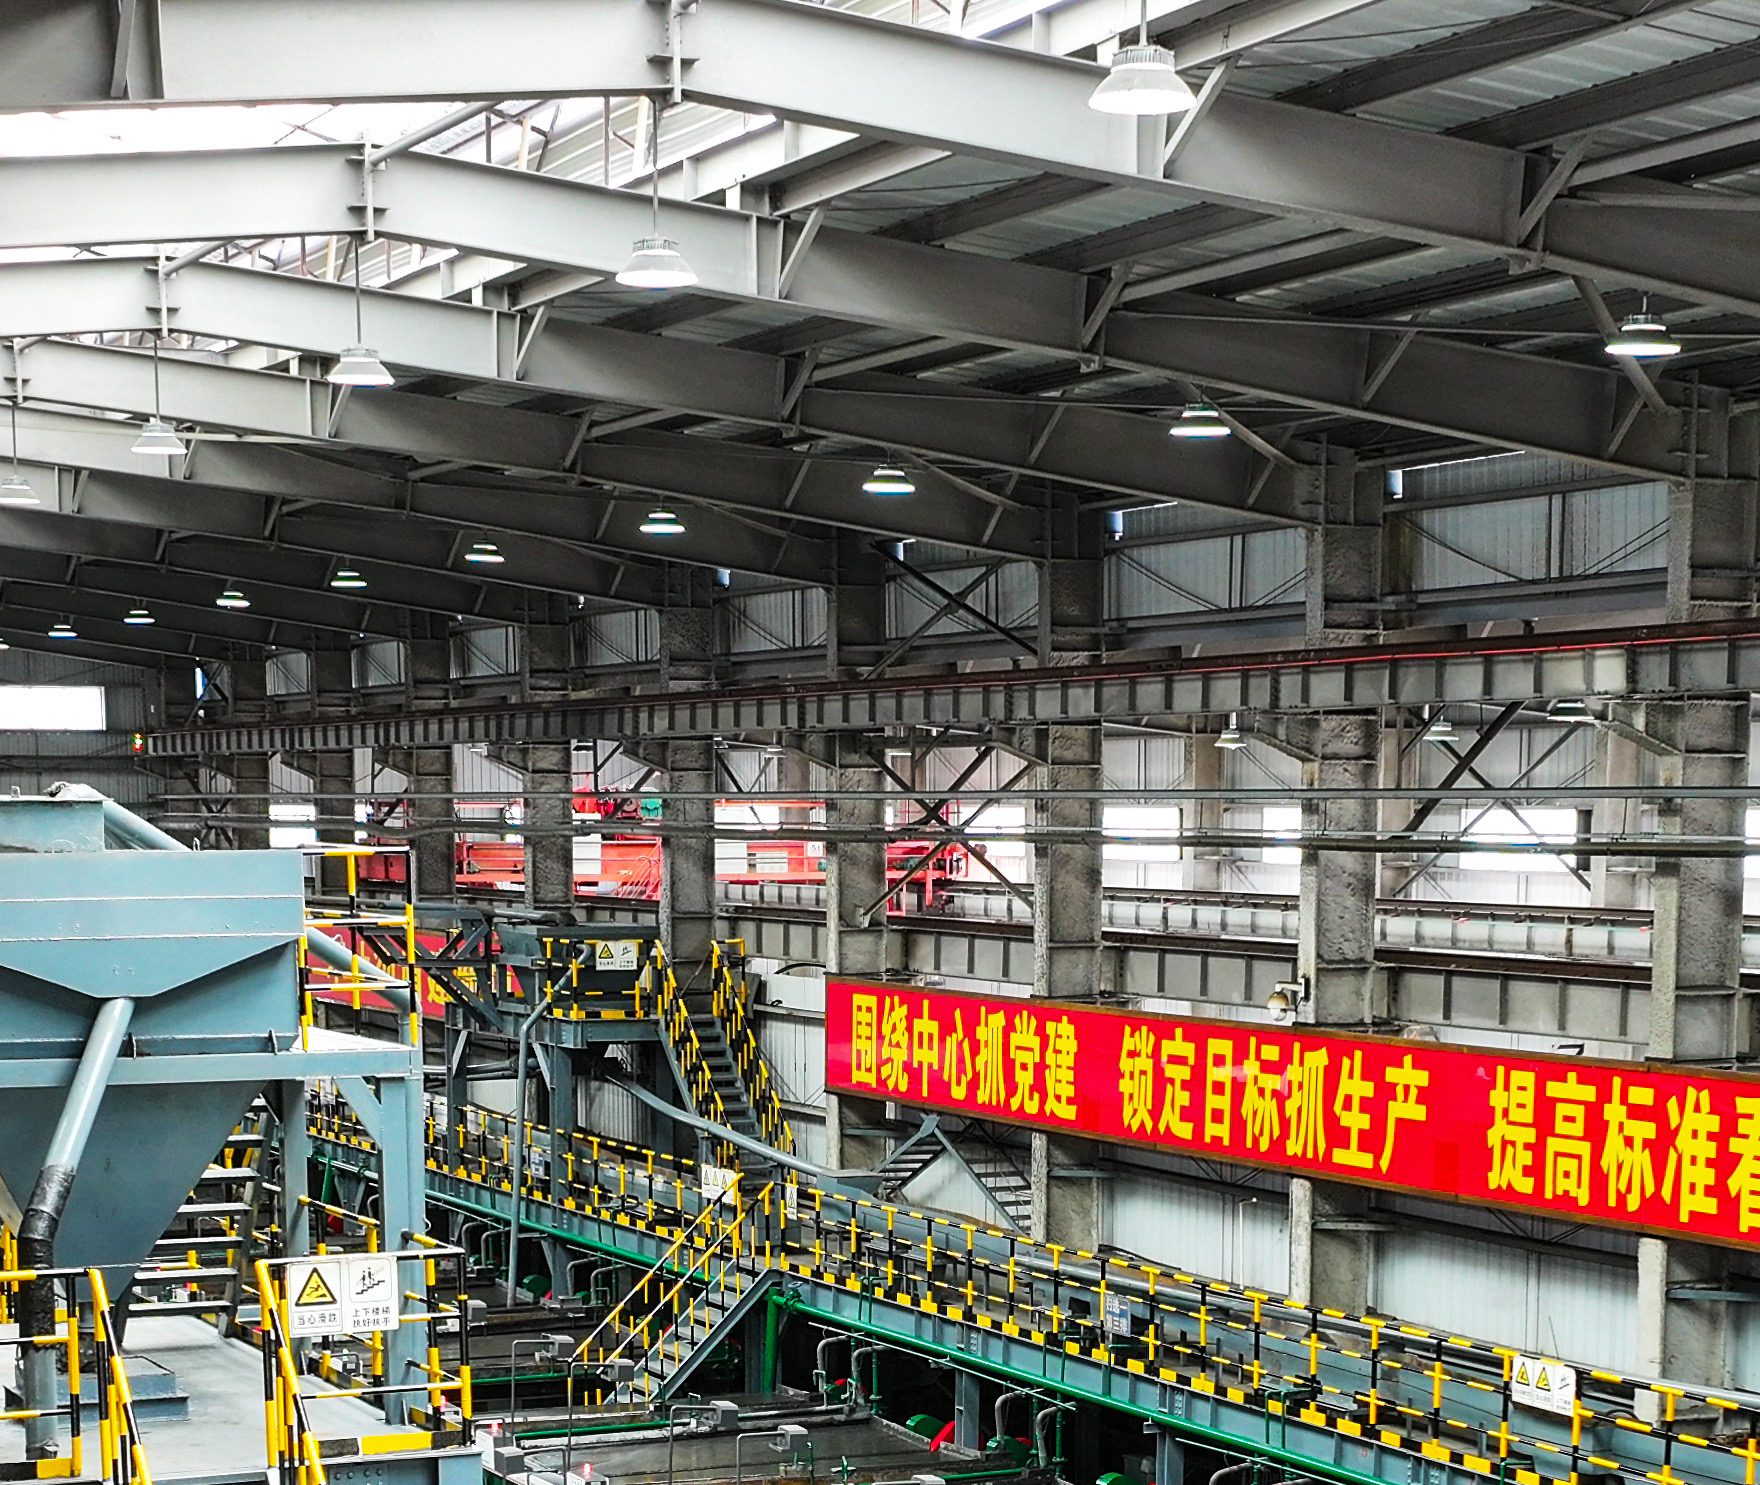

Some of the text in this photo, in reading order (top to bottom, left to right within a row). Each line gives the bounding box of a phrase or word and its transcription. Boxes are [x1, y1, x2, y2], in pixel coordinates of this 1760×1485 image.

[851, 992, 1078, 1122] 围绕中心抓党建
[1119, 1024, 1430, 1174] 锁定目标抓生产
[296, 1313, 339, 1326] 当心滑跌
